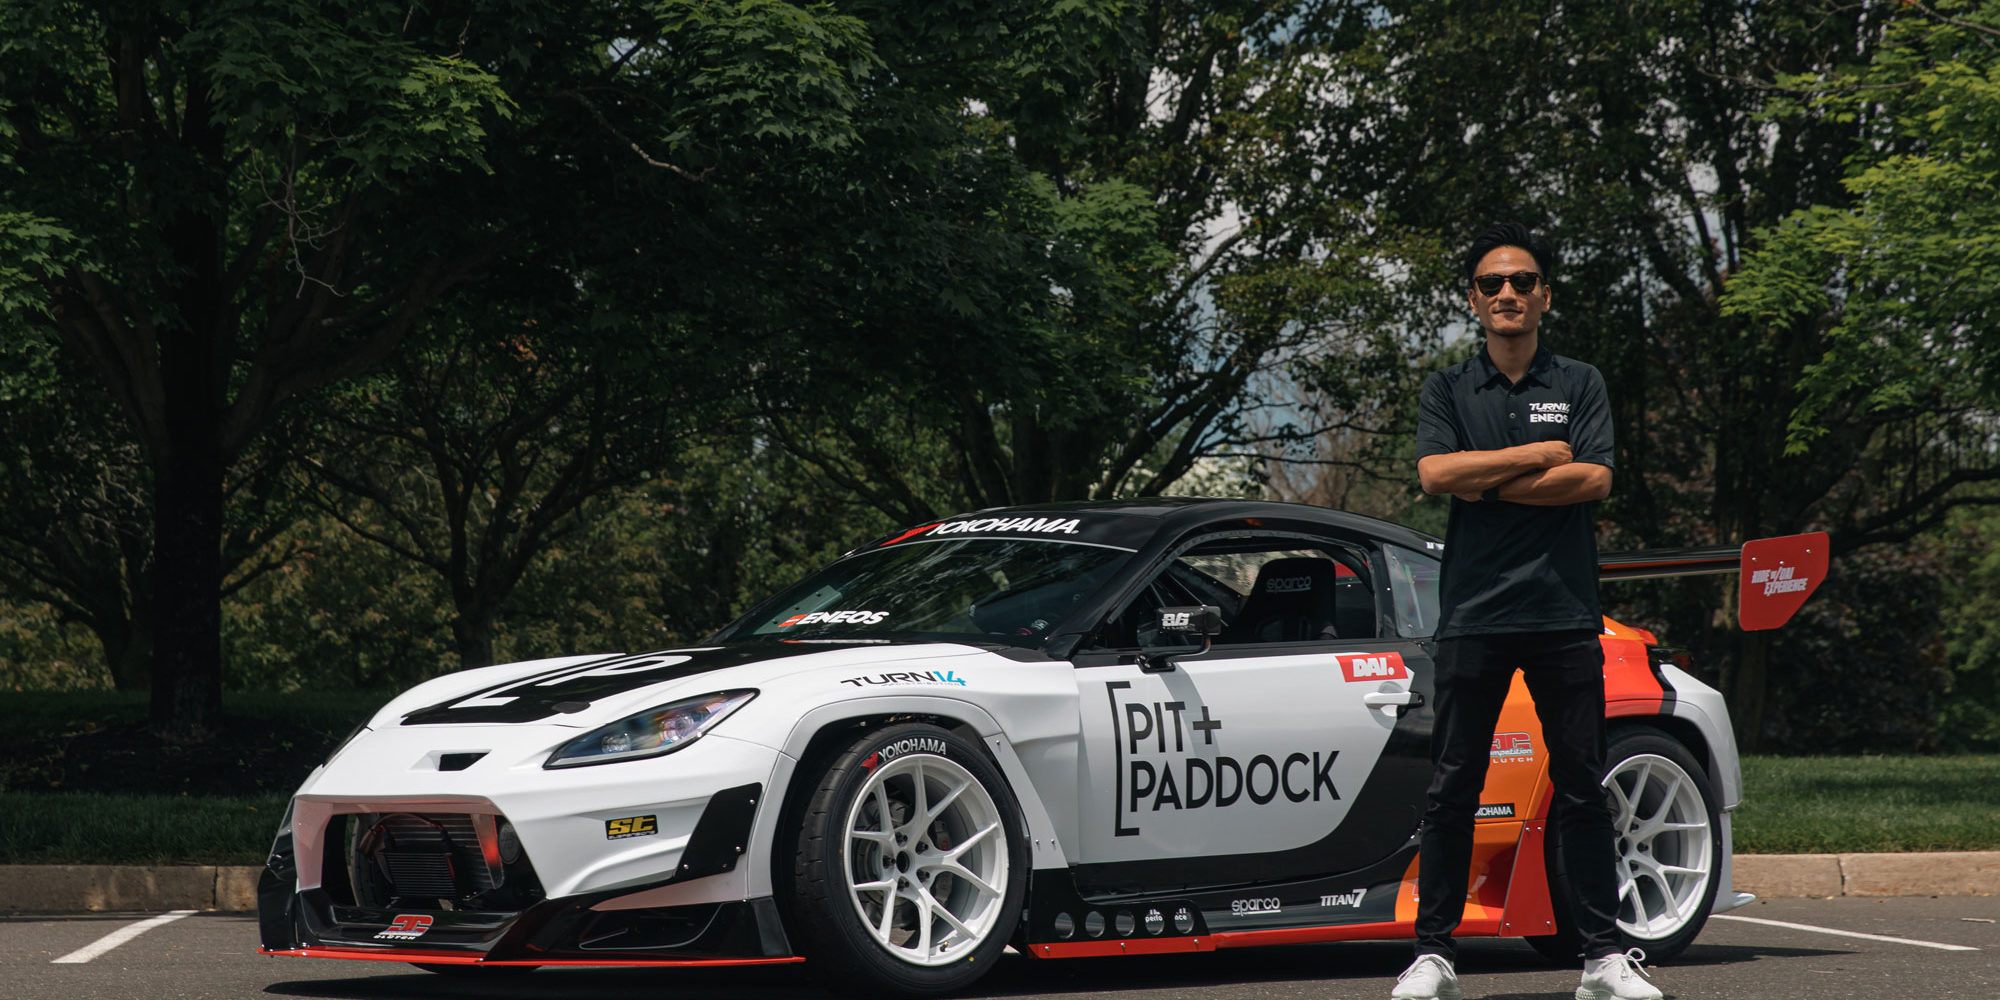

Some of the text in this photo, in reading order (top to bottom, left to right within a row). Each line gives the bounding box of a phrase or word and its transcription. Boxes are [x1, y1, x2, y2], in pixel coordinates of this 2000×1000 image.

[1529, 413, 1569, 424] ENEOS
[926, 518, 1080, 537] YOKOHAMA
[1266, 576, 1312, 592] sparco
[1763, 578, 1808, 597] EXPERIENCE
[796, 610, 890, 625] ENEOS
[840, 670, 967, 687] TURN14
[878, 738, 947, 762] YOKOHAMA
[1130, 750, 1341, 813] PADDOCK
[1231, 897, 1281, 917] sparco
